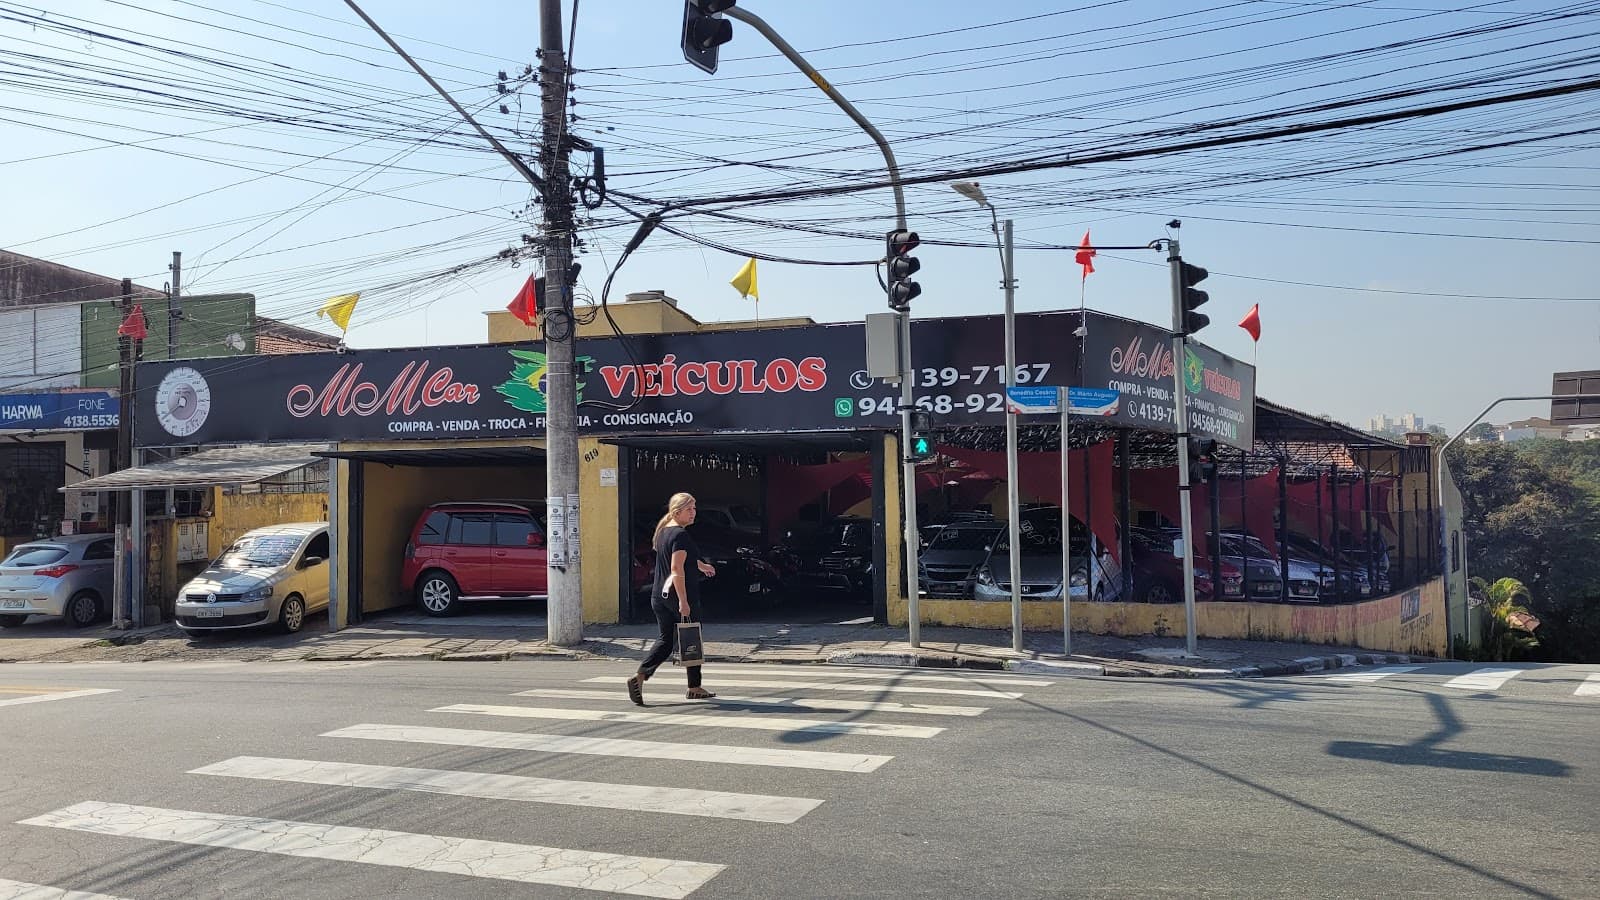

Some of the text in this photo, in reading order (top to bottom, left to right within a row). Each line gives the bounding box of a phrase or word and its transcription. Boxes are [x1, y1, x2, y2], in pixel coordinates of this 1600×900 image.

[600, 354, 827, 398] VEÍCULOS
[1109, 380, 1141, 396] COMPRA
[1146, 386, 1169, 402] VENDA
[79, 398, 105, 410] FONE
[2, 405, 43, 420] HARWA
[63, 414, 119, 427] 4138.5536
[388, 421, 434, 432] COMPRA
[442, 420, 480, 431] VENDA
[488, 418, 527, 430] TROCA
[603, 409, 693, 426] CONSIGNAÇÃO
[584, 447, 599, 463] 619
